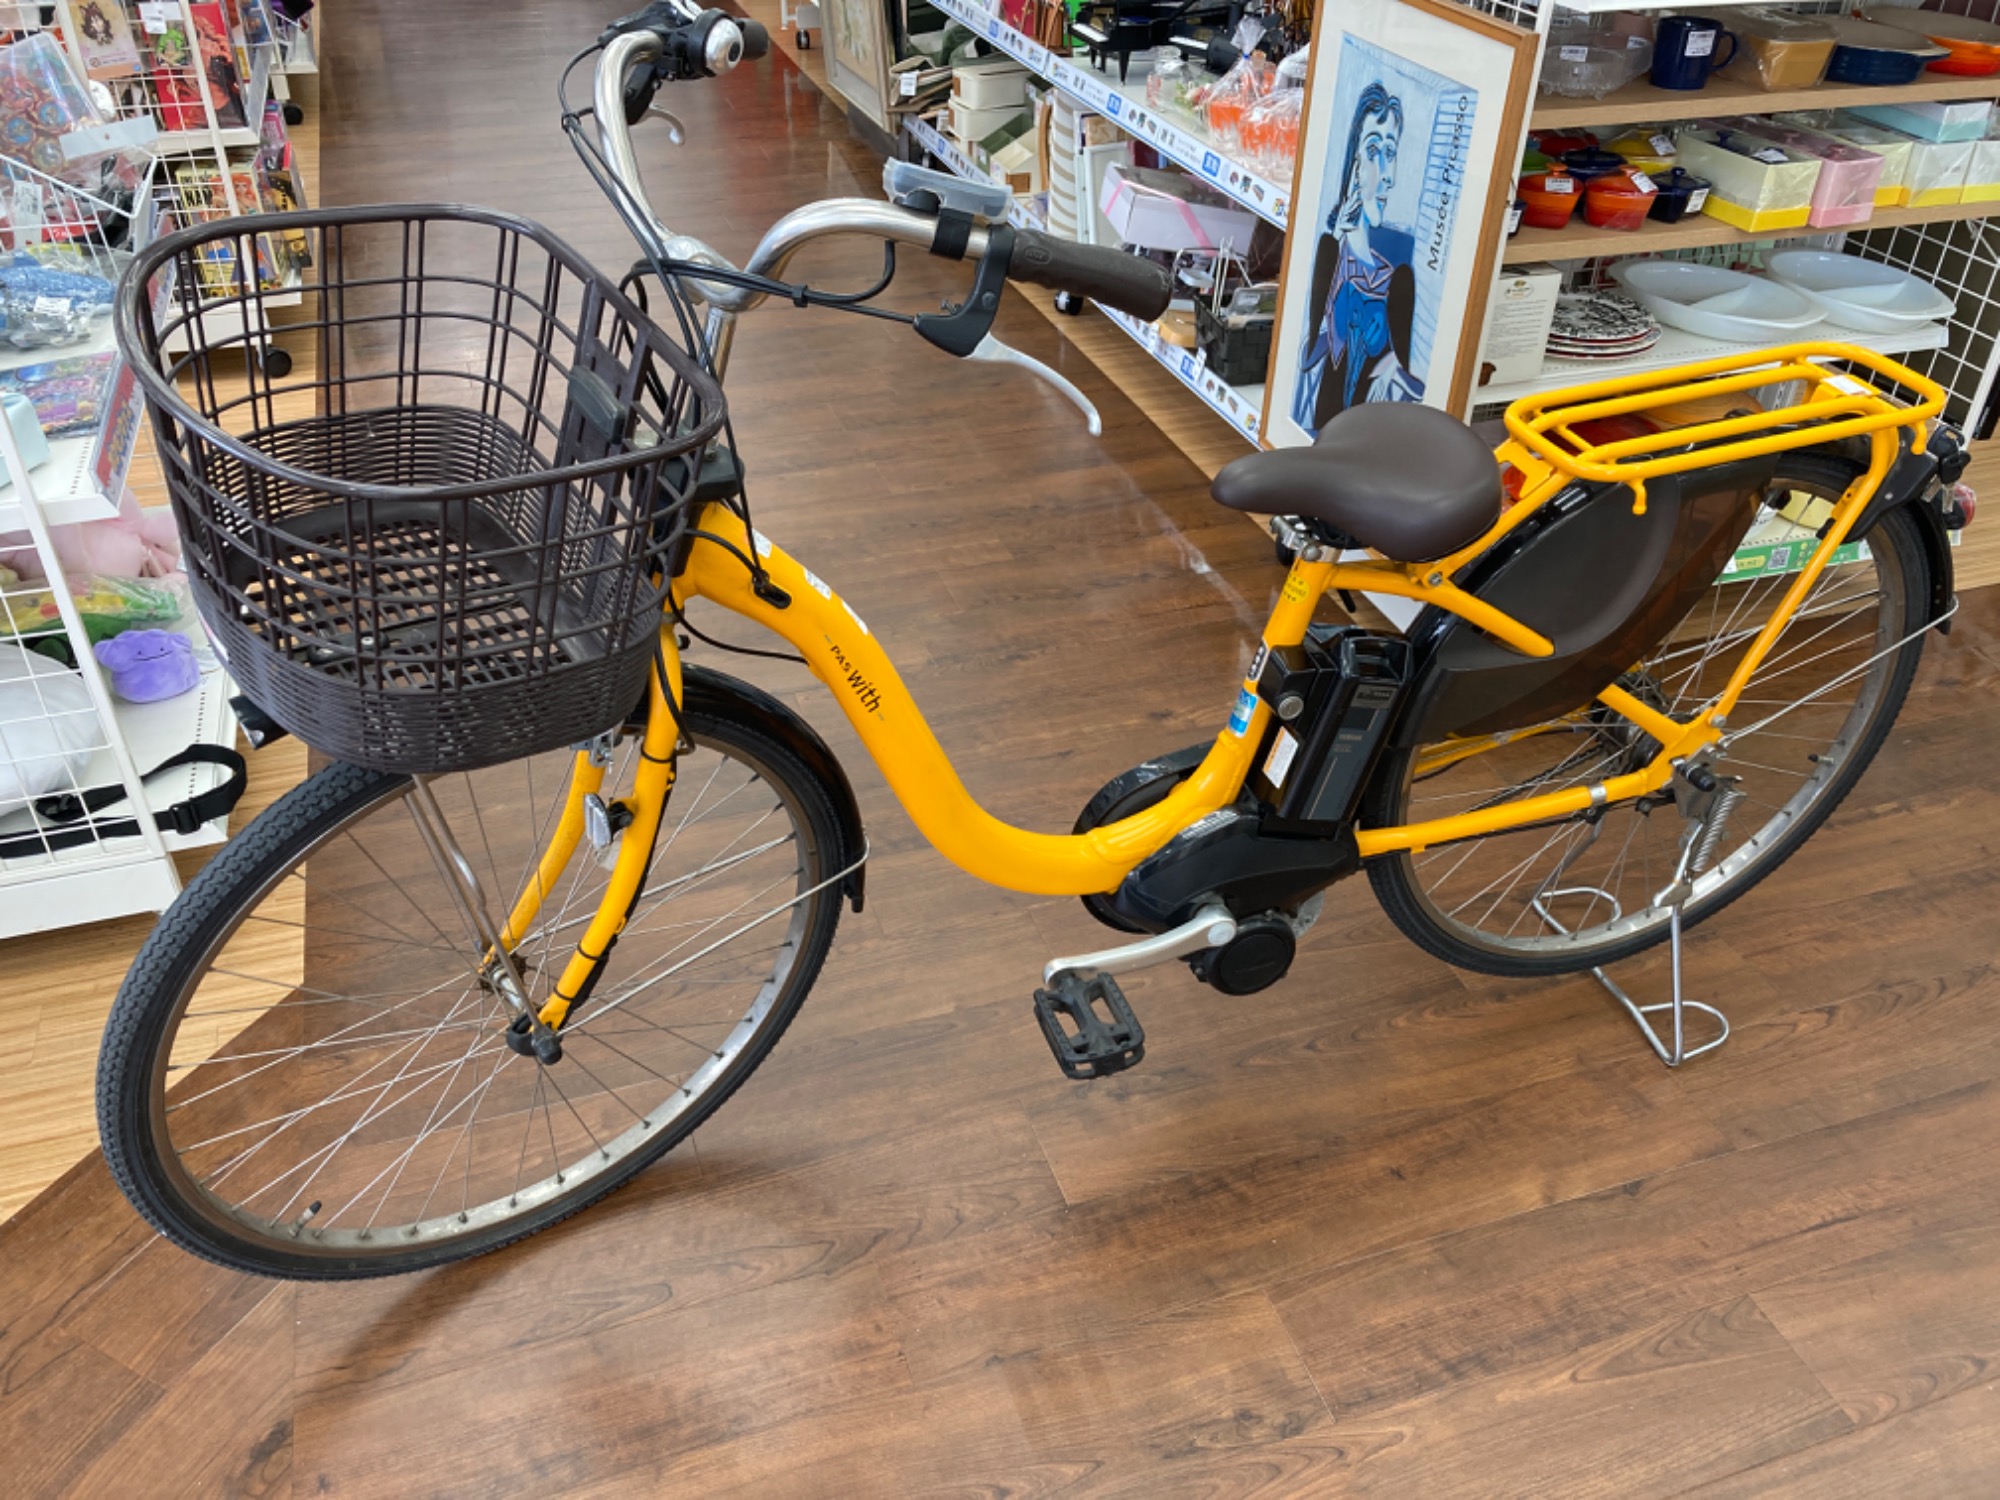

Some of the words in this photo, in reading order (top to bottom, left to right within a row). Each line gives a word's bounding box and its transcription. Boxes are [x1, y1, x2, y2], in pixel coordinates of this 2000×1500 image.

[1426, 191, 1450, 272] Musée
[1441, 94, 1469, 185] Picasso
[830, 644, 851, 673] PAS
